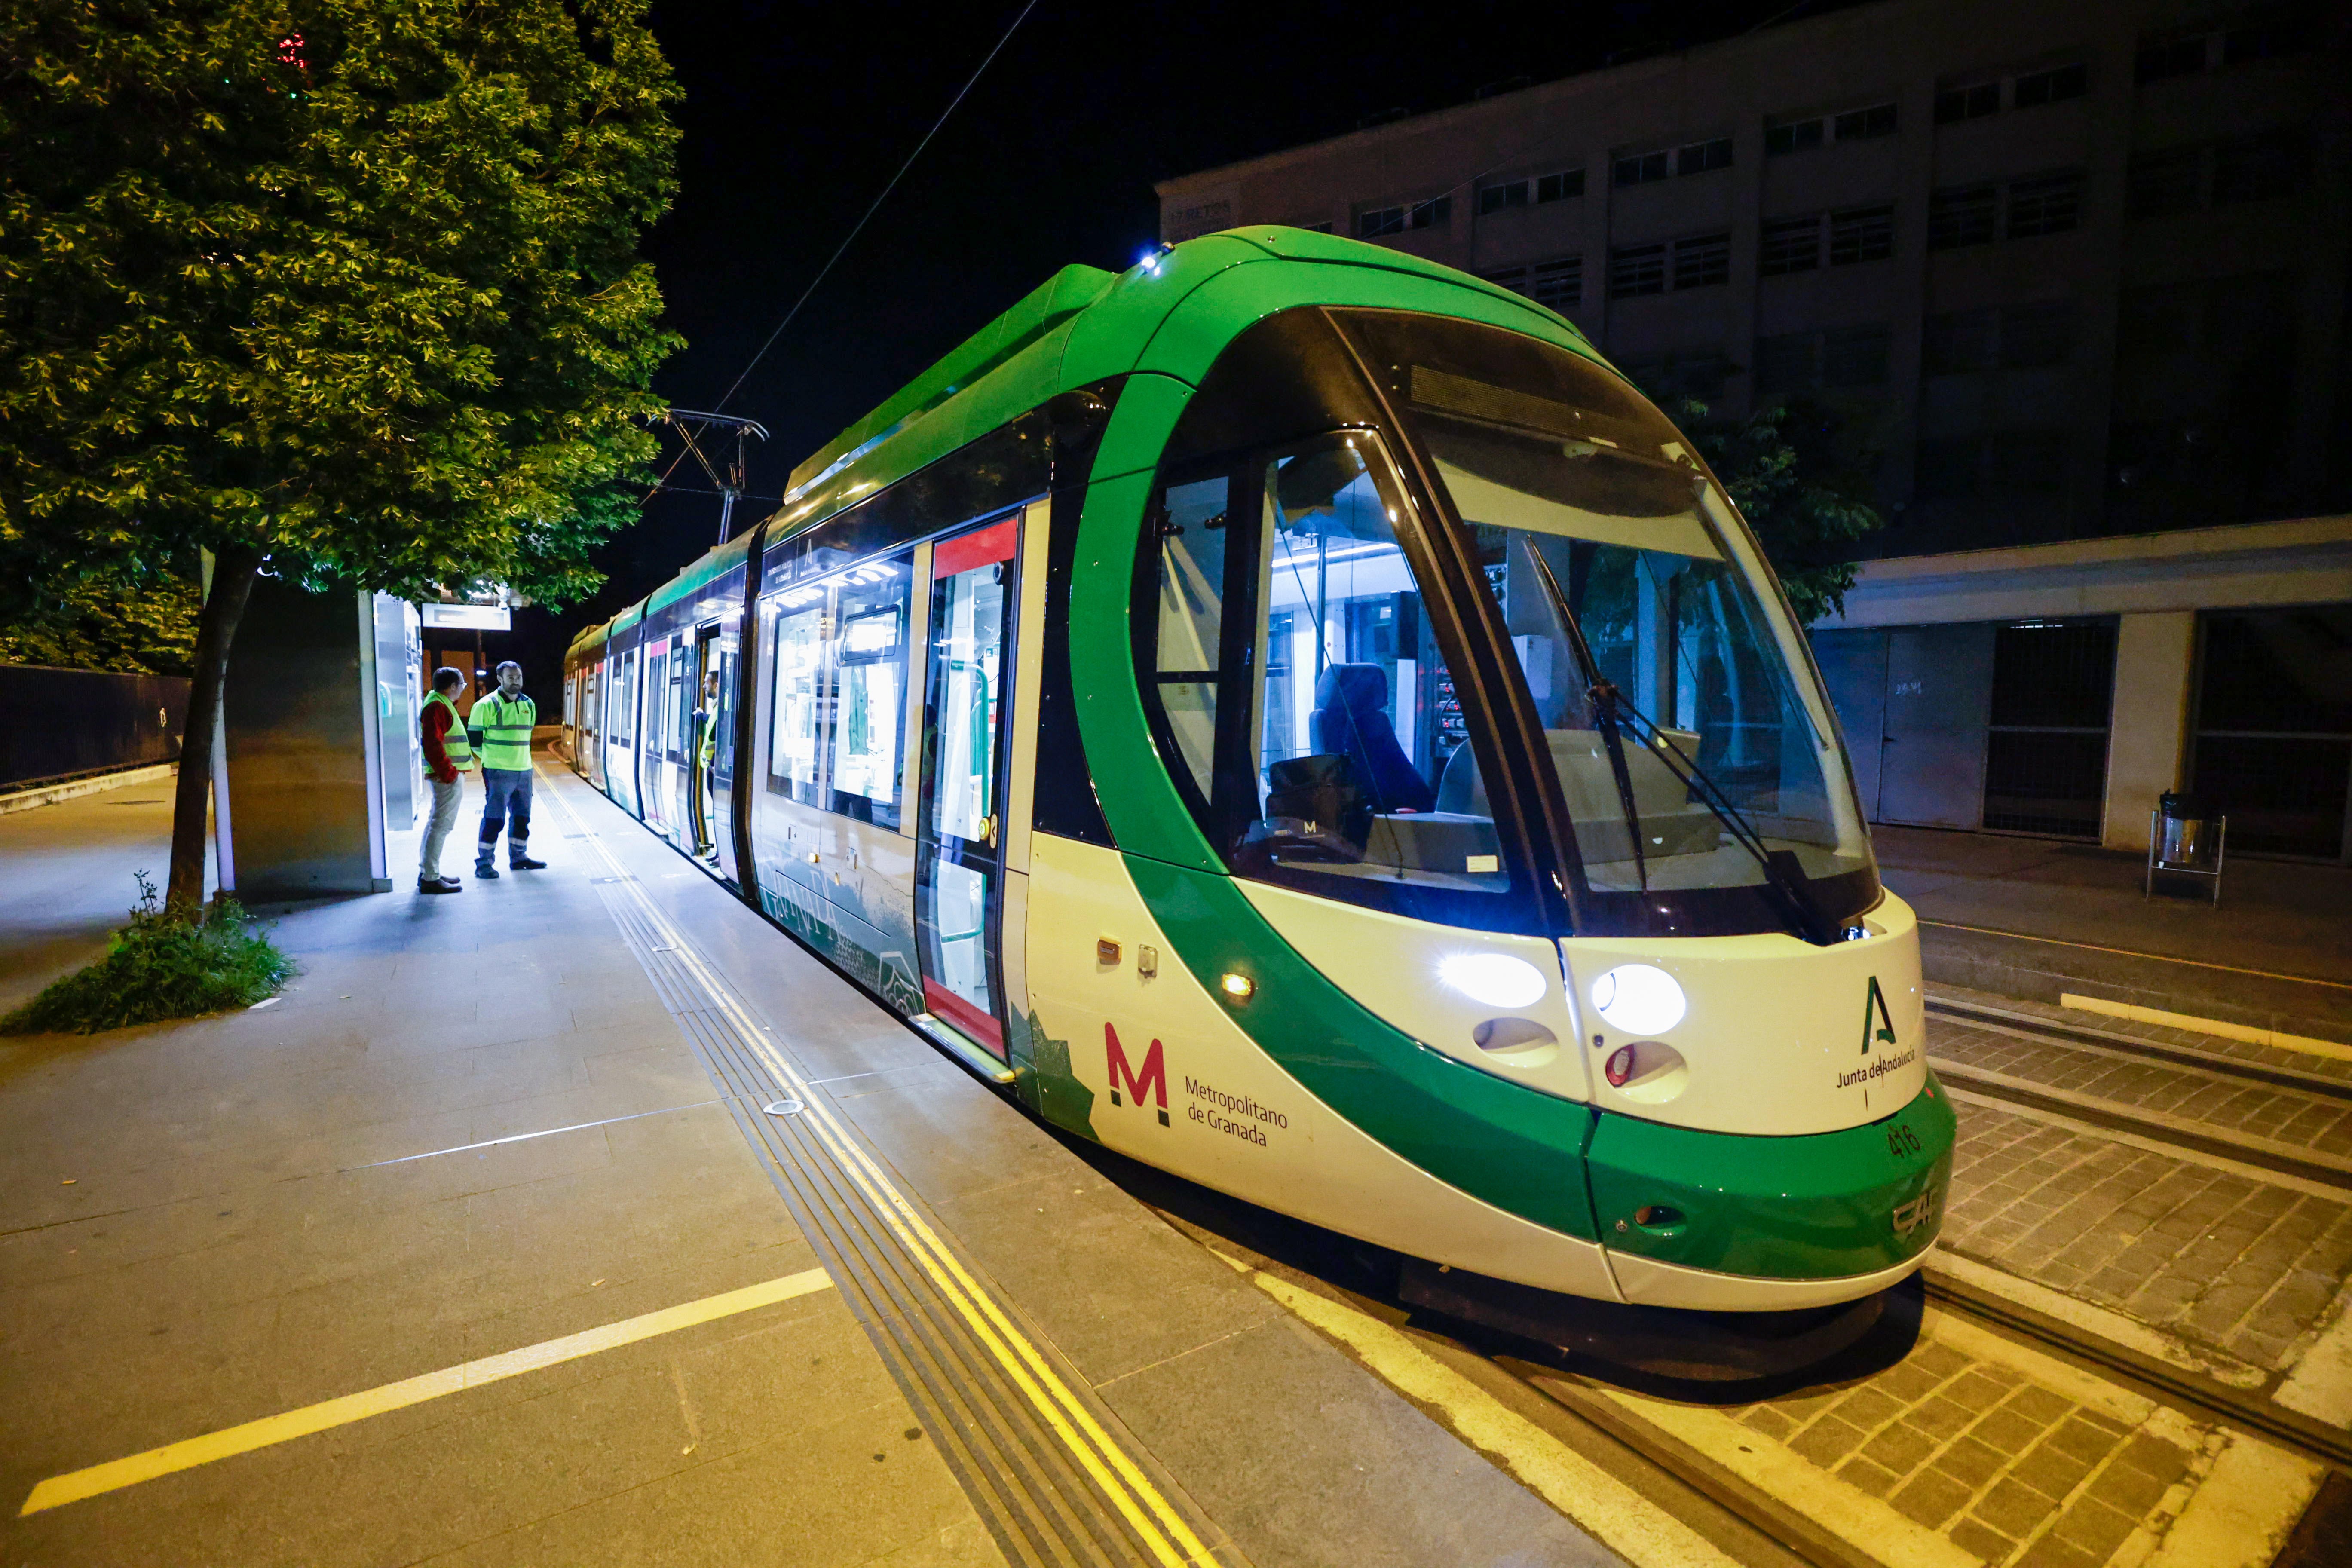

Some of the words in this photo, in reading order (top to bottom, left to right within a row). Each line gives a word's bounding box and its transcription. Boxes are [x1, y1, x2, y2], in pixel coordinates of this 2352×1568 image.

[1105, 1022, 1170, 1128] M
[1837, 1069, 1867, 1088] Junta
[1869, 1062, 1880, 1078] de
[1883, 1044, 1915, 1074] Andalucía
[1185, 1076, 1288, 1129] Metropolitano
[1188, 1102, 1204, 1124] de
[1208, 1109, 1267, 1147] Granada
[1888, 1124, 1920, 1158] 416
